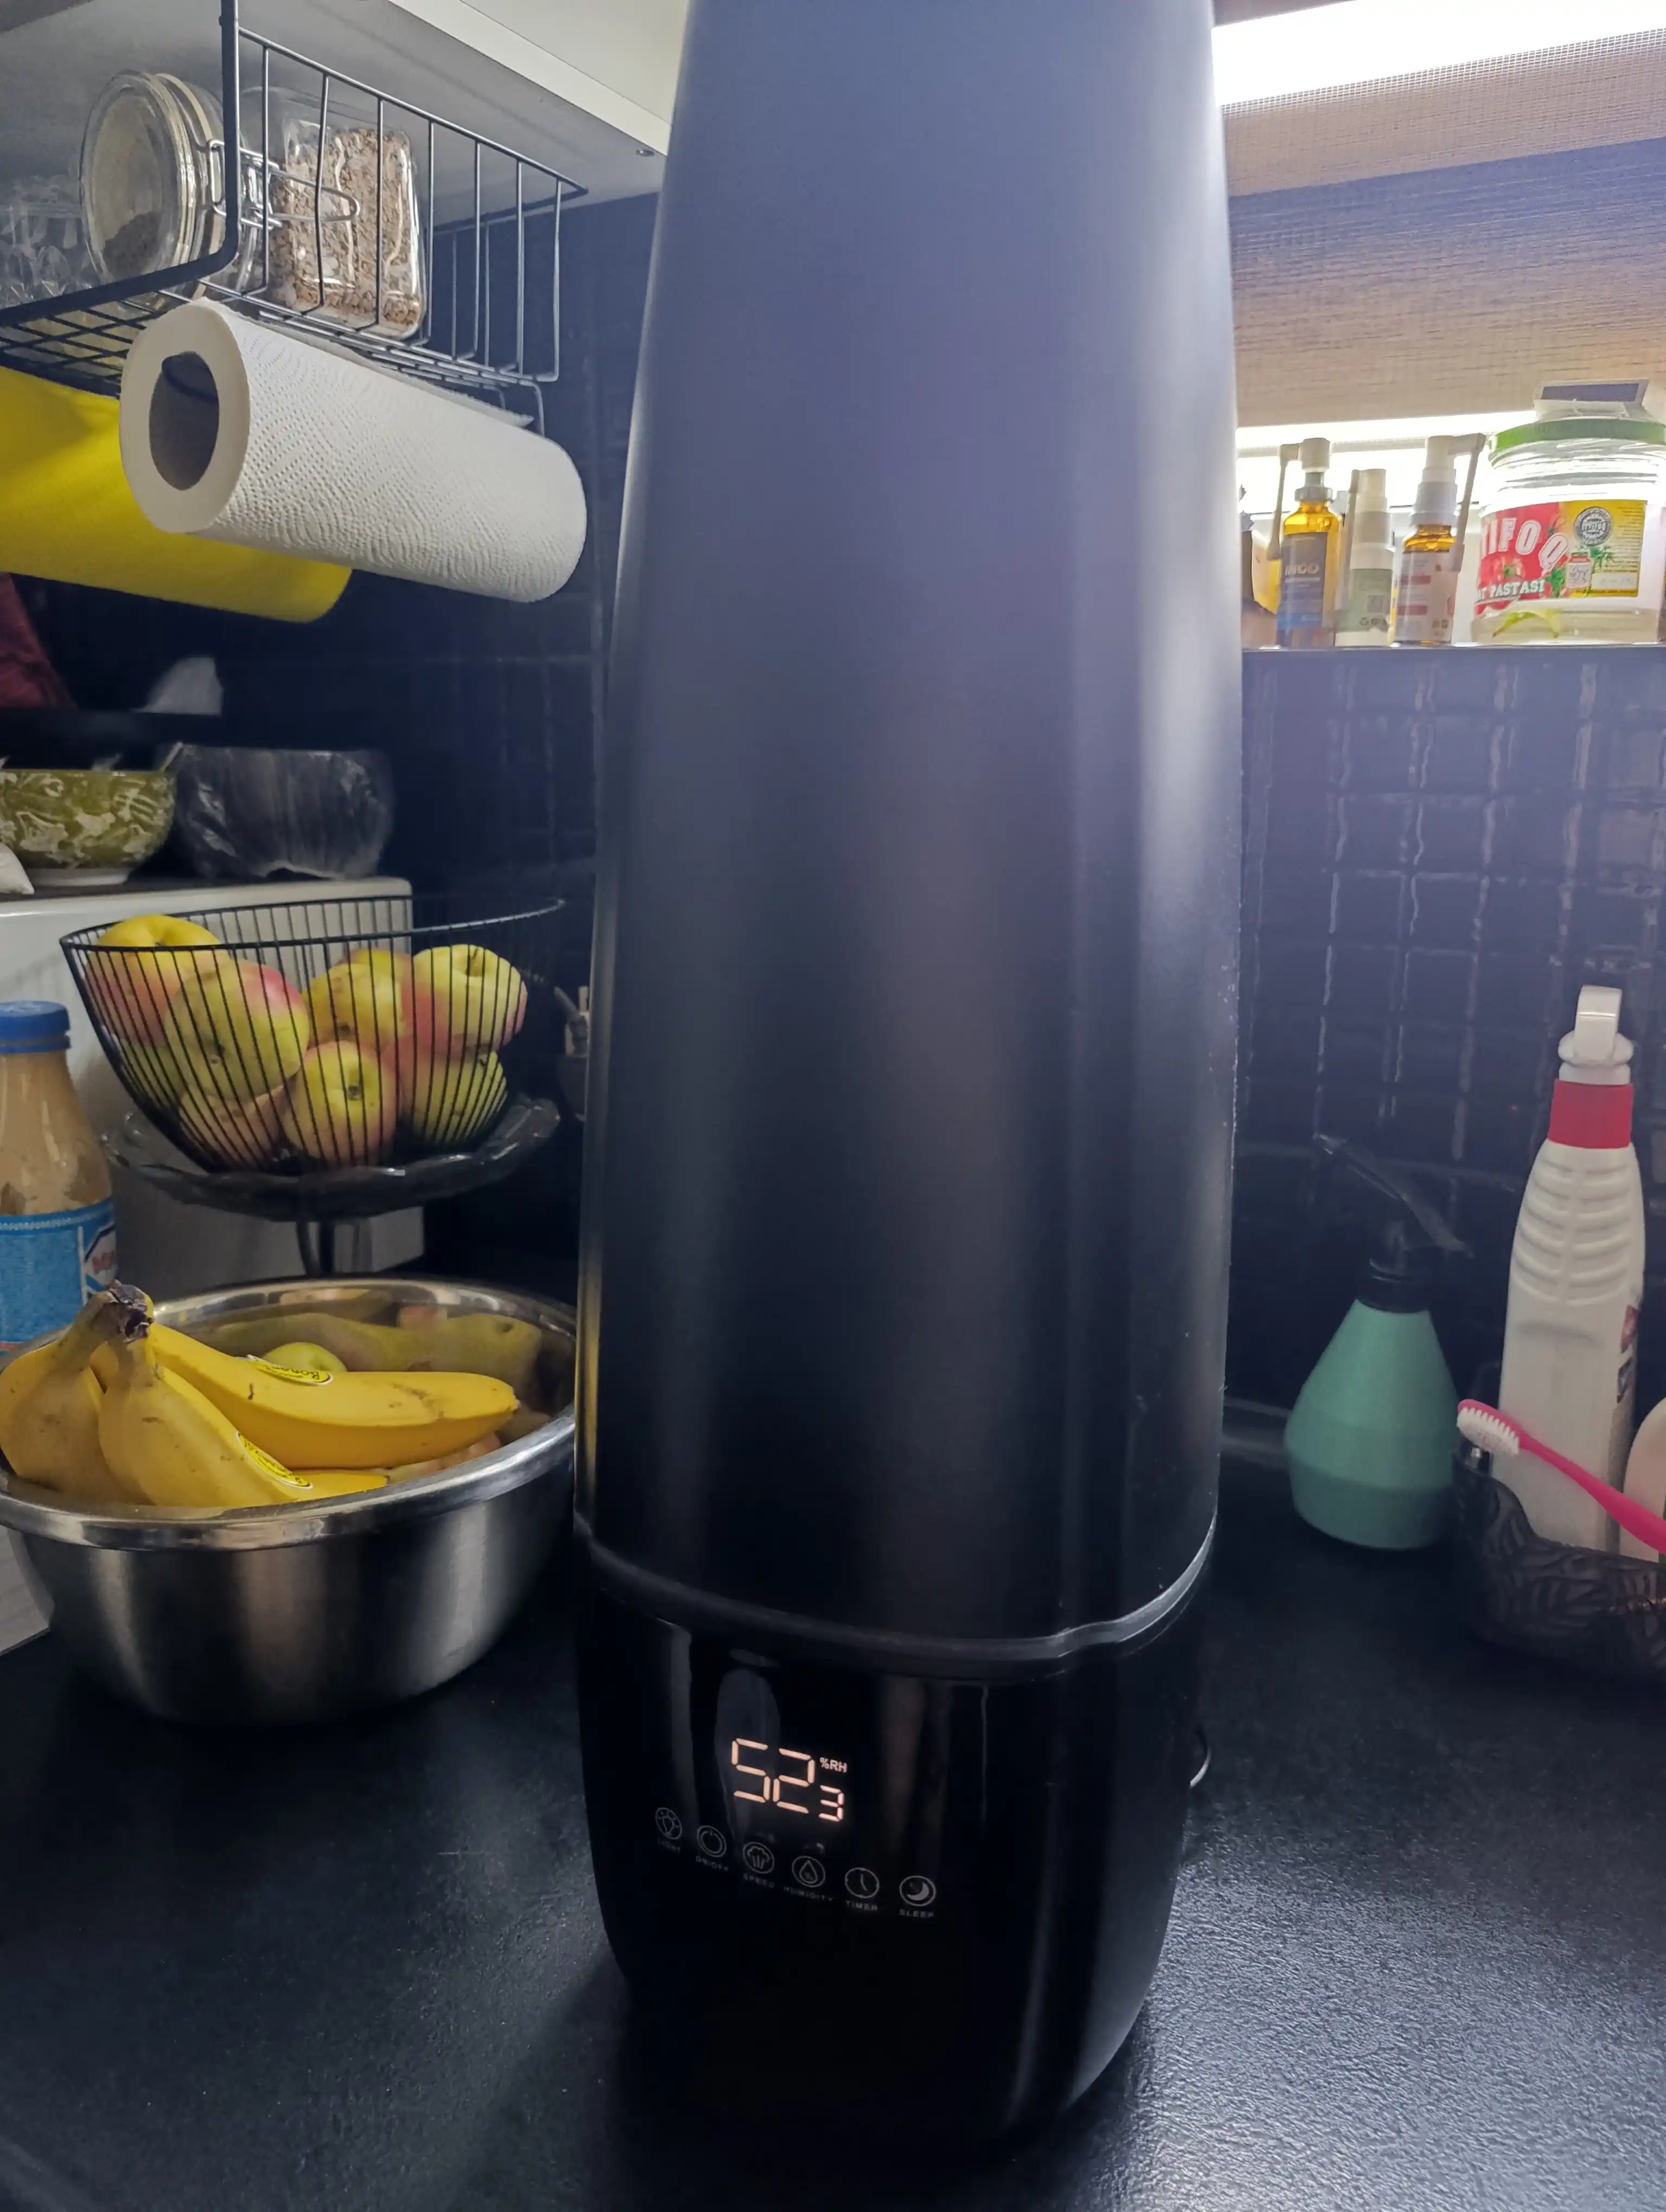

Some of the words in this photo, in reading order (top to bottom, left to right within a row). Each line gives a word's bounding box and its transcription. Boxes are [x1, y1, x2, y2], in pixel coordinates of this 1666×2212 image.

[1490, 580, 1546, 599] PASTASI
[819, 1757, 848, 1773] %RH
[731, 1738, 816, 1814] 52
[818, 1785, 844, 1822] 3
[743, 1873, 776, 1888] SPEED
[783, 1885, 833, 1902] HUMIDITY
[845, 1899, 878, 1912] TIMER
[899, 1908, 934, 1918] SLEEP
